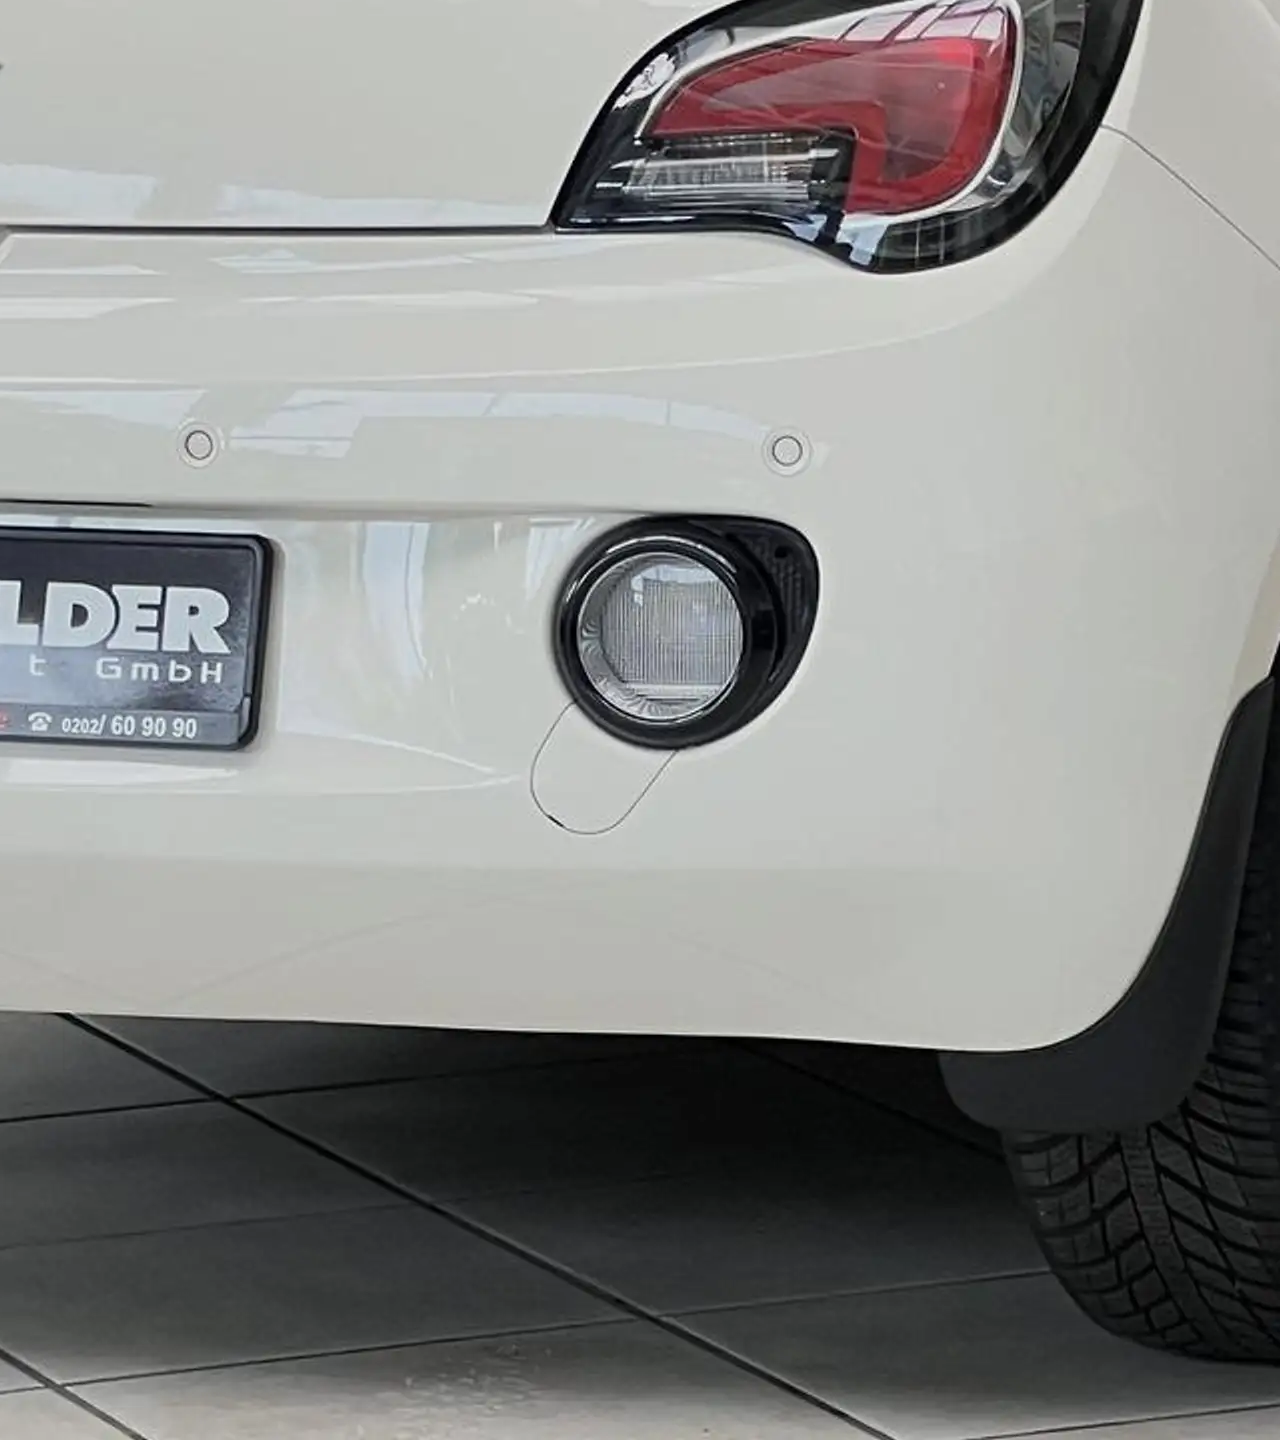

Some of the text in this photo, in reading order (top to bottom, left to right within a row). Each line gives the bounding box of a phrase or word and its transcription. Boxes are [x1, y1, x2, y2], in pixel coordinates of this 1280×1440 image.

[96, 656, 224, 684] GmbH
[111, 715, 136, 735] 60
[141, 716, 167, 738] 90
[172, 718, 198, 740] 90
